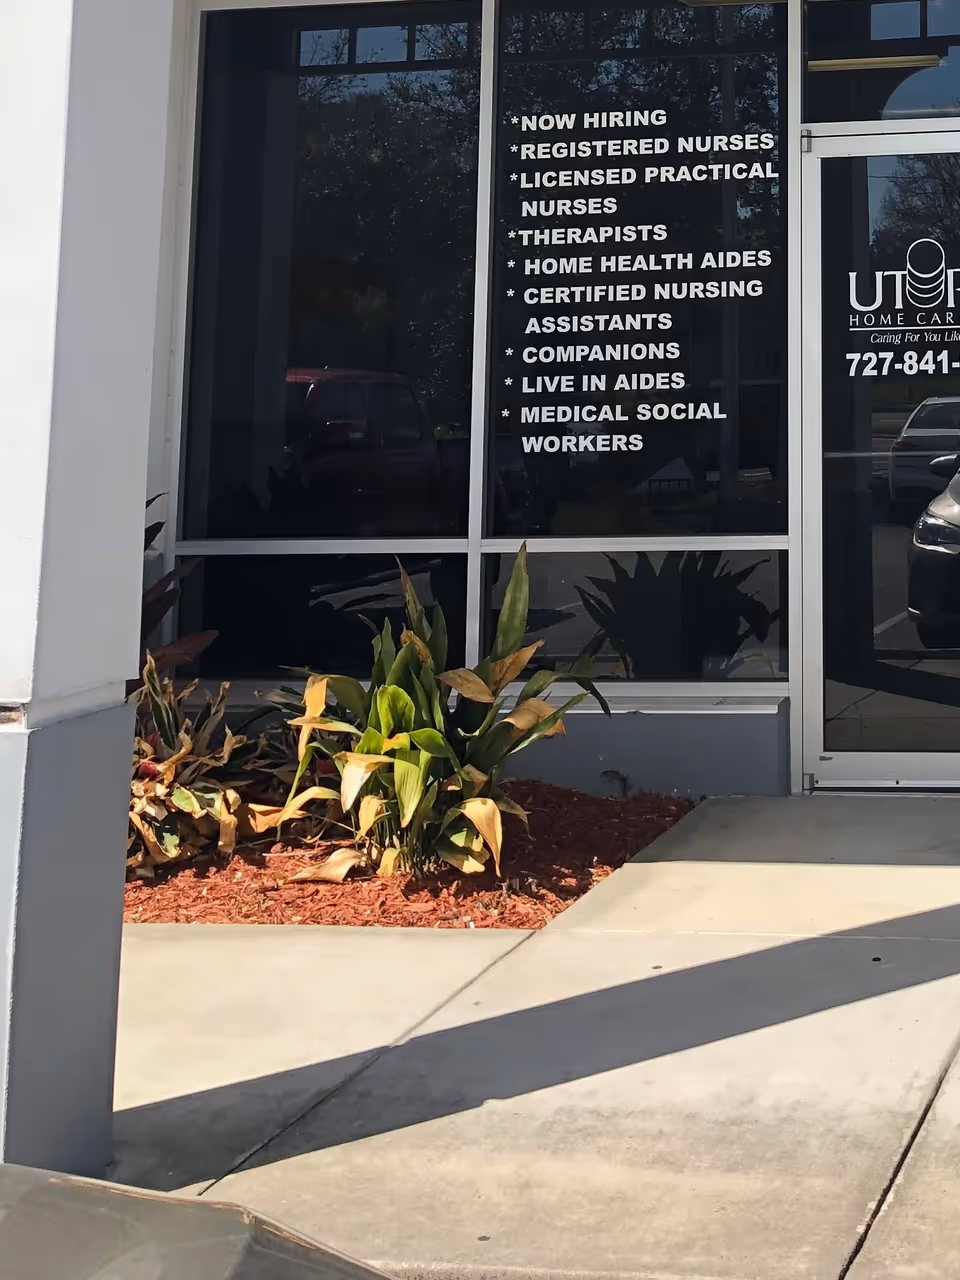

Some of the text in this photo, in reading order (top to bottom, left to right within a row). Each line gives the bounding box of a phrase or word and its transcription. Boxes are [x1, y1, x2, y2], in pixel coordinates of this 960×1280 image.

[521, 109, 667, 132] NOW HIRING
[520, 133, 775, 160] REGISTERED NURSES
[520, 162, 779, 189] LICENSED PRACTICAL
[521, 197, 618, 217] NURSES
[517, 224, 668, 246] THERAPISTS
[524, 249, 772, 275] HOME HEALTH AIDES
[523, 279, 763, 305] CERTIFIED NURSING
[524, 313, 673, 334] ASSISTANTS
[849, 313, 905, 327] HOME
[870, 331, 902, 346] Caring
[904, 331, 921, 343] For
[924, 331, 942, 343] You
[522, 342, 680, 364] COMPANIONS
[522, 372, 685, 393] LIVE IN AIDES
[521, 402, 727, 423] MEDICAL SOCIAL
[521, 434, 643, 453] WORKERS
